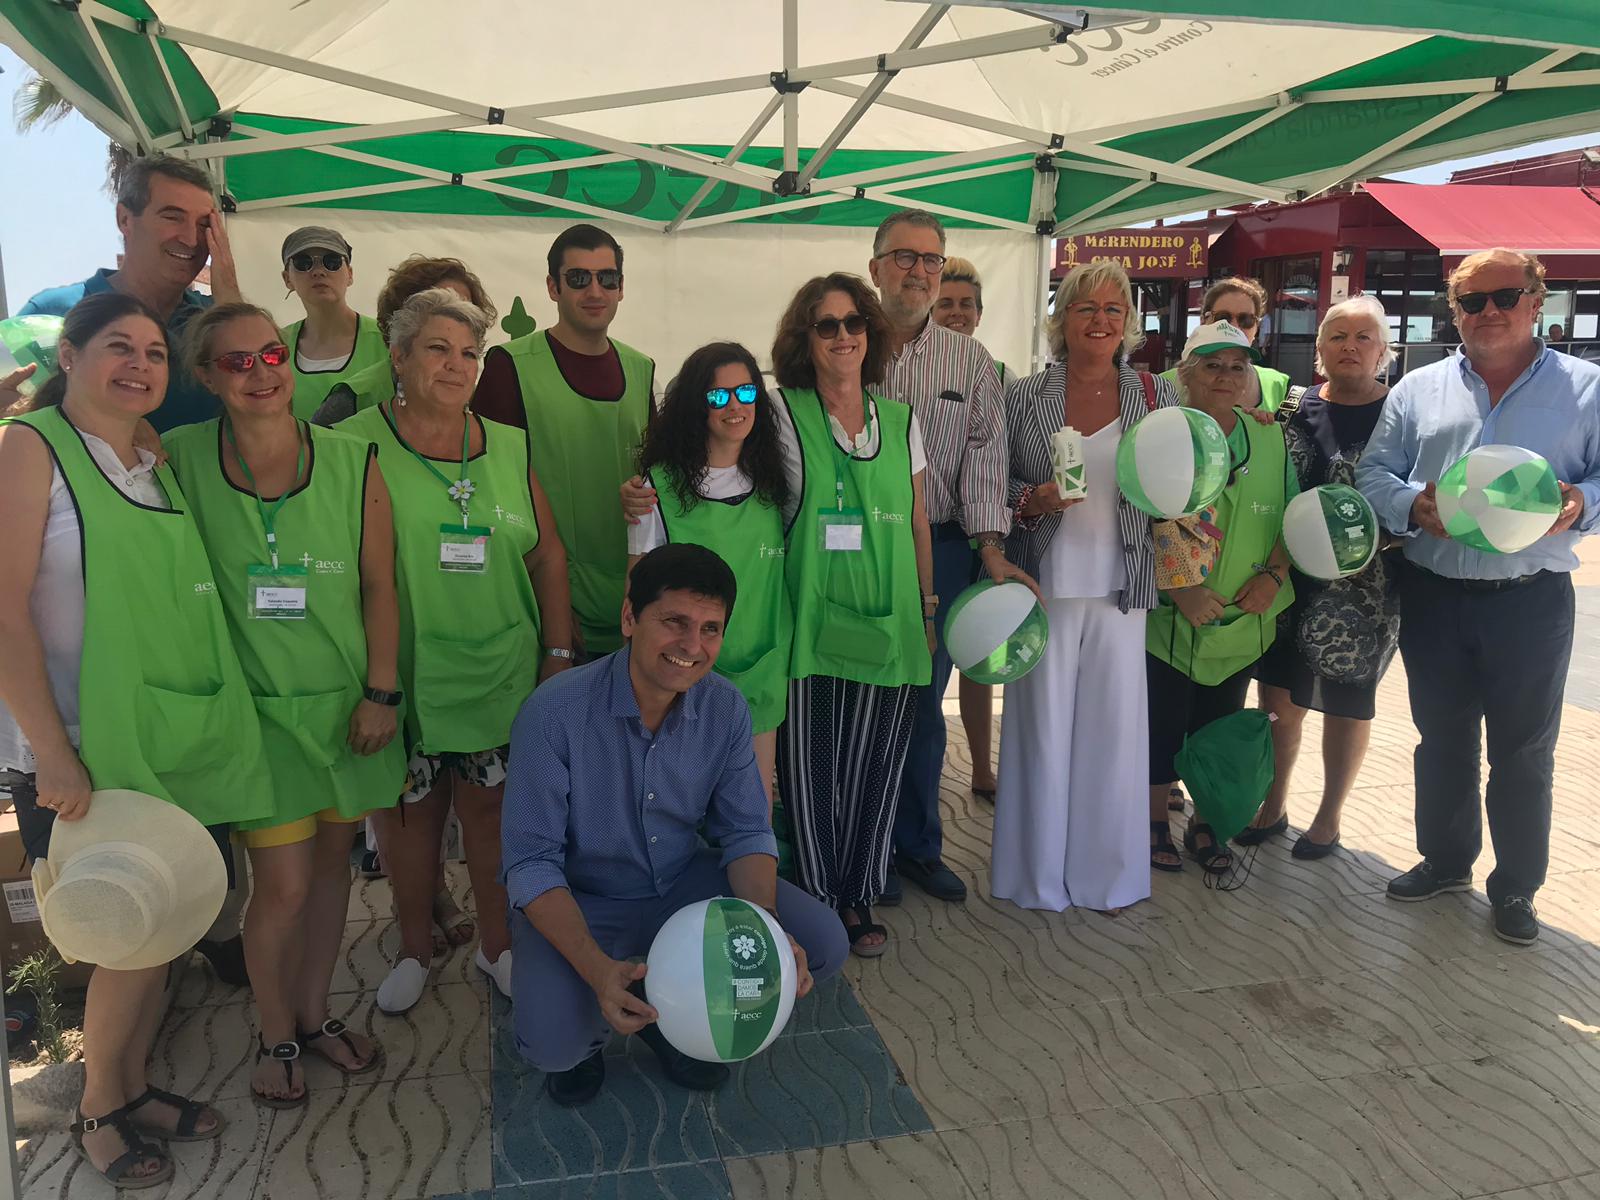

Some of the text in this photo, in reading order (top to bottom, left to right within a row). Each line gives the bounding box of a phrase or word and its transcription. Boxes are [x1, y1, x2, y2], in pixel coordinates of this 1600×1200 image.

[1085, 235, 1185, 248] MERENDERO
[1137, 253, 1177, 270] JOSÉ
[881, 512, 904, 521] aecc
[315, 559, 345, 570] aecc
[741, 1011, 762, 1020] aecc
